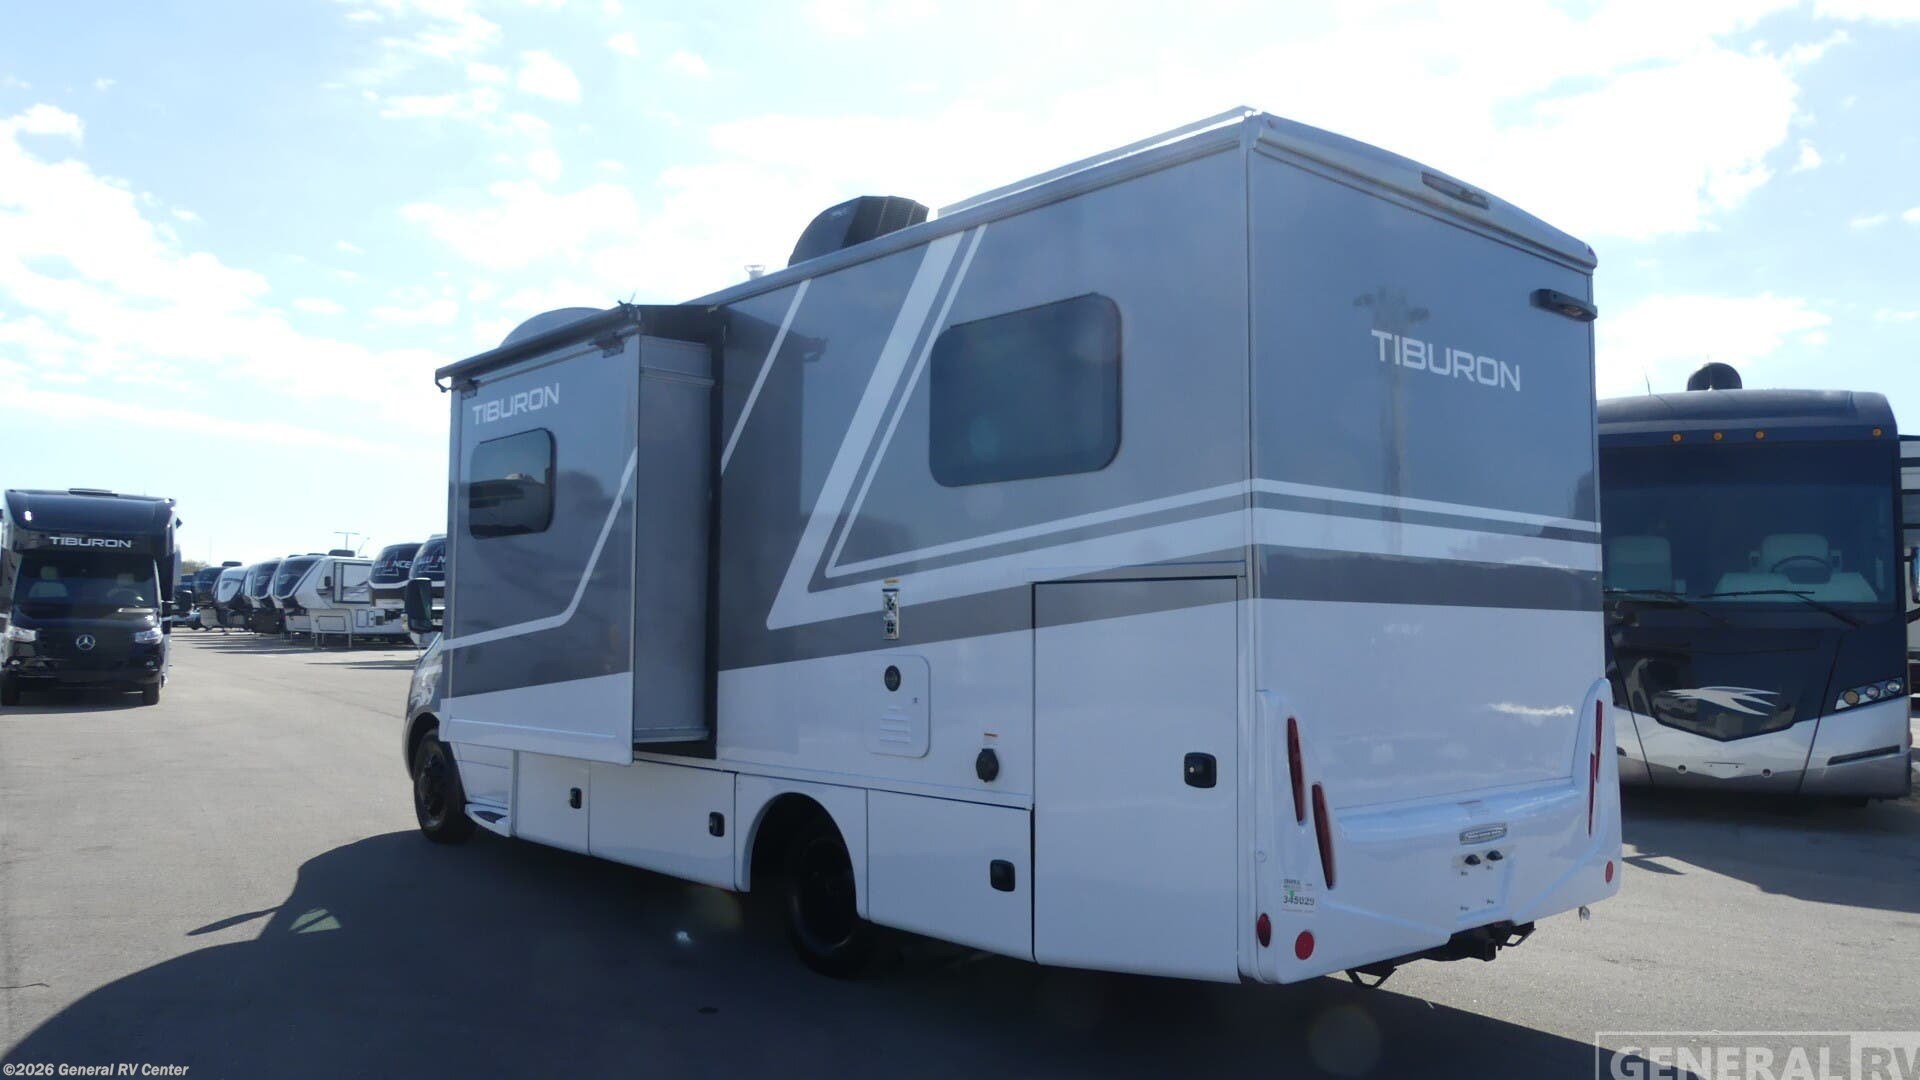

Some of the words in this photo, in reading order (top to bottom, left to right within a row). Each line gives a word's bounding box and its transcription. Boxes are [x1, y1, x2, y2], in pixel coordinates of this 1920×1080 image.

[1371, 329, 1520, 392] TIBURON
[472, 382, 560, 425] TIBURON
[49, 536, 132, 548] TIBURON
